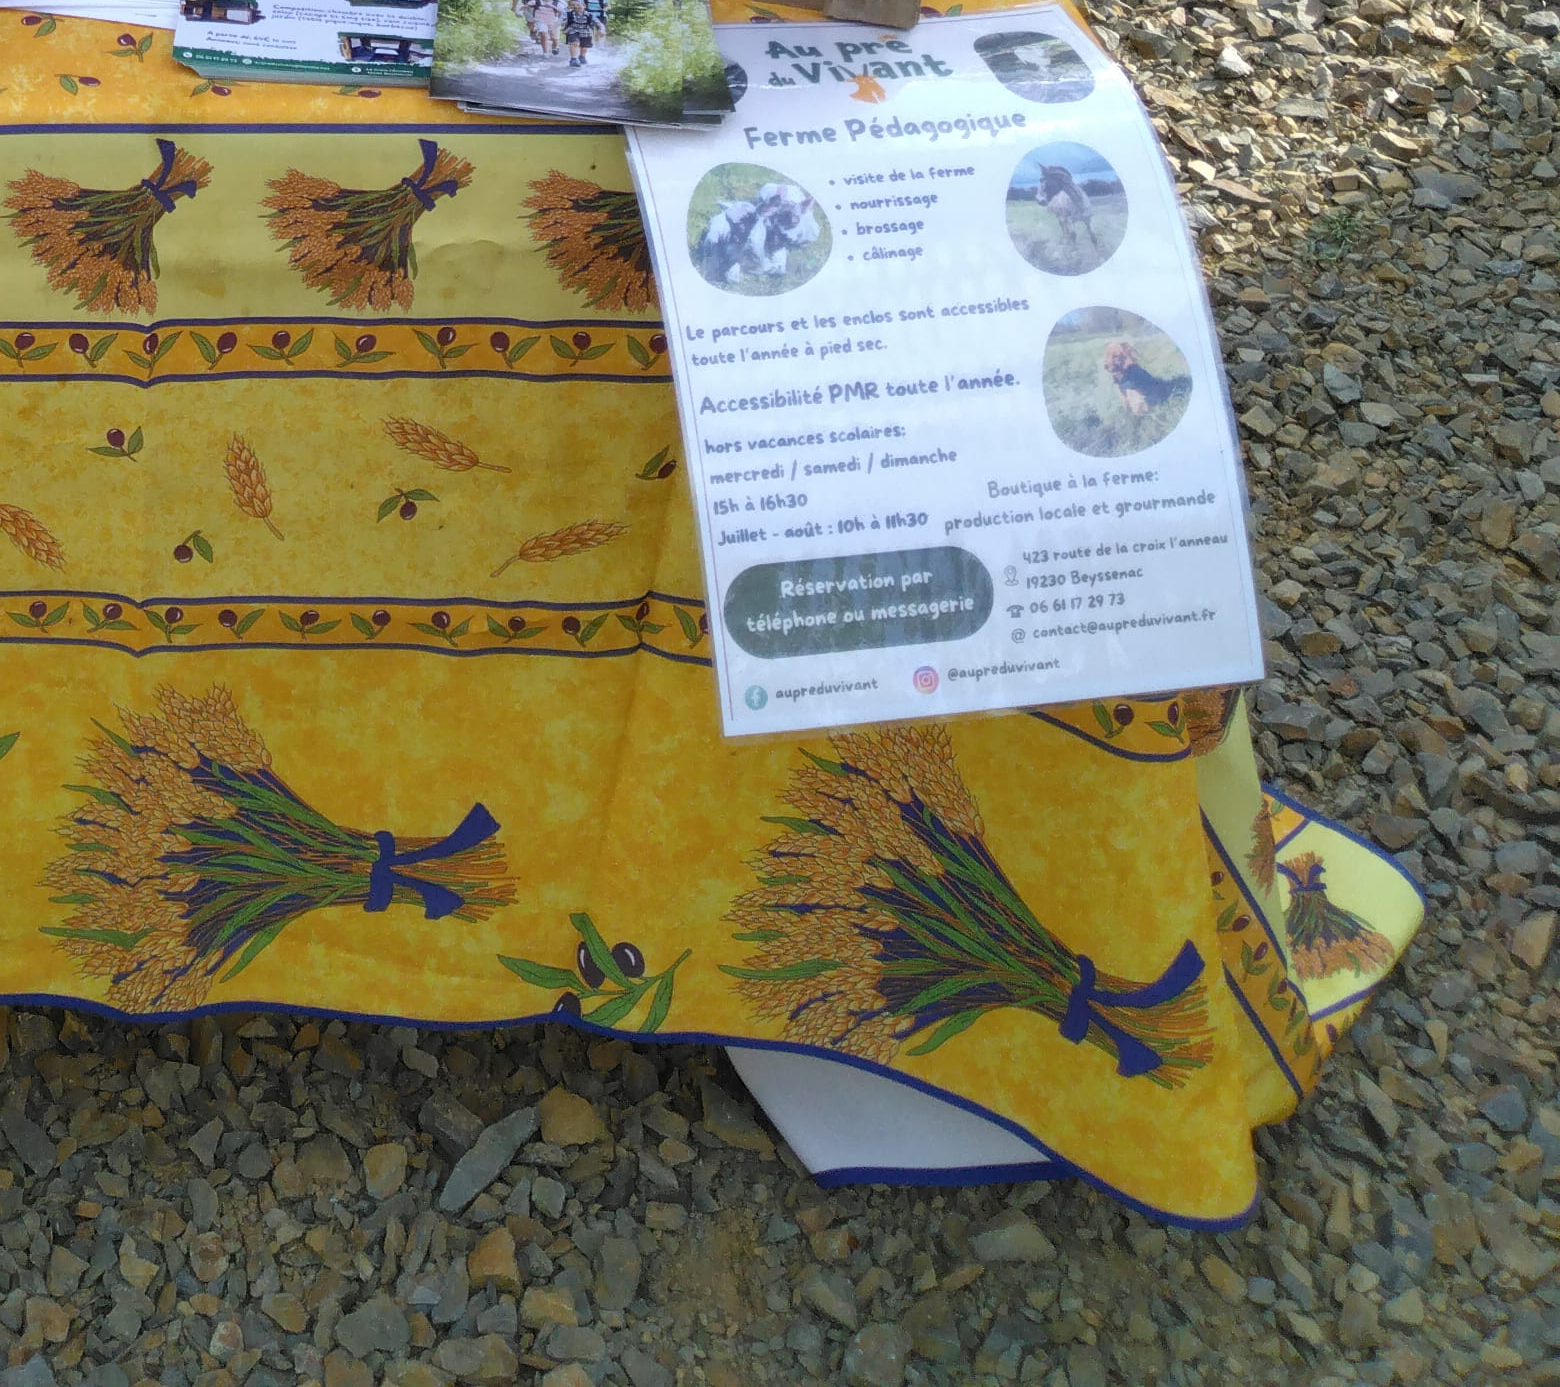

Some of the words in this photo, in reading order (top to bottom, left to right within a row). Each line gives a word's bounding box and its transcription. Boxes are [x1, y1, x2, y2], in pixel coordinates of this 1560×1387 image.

[765, 40, 823, 59] Au
[768, 72, 796, 88] du
[791, 53, 954, 84] Vivant
[743, 125, 837, 151] Ferme
[844, 111, 1026, 142] Pédagogique
[844, 173, 884, 187] visite
[889, 169, 906, 183] de
[910, 167, 925, 181] la
[929, 164, 975, 178] ferme
[849, 192, 939, 212] nourrissage
[856, 219, 924, 236] brossage
[862, 246, 924, 262] câlinage
[686, 325, 705, 342] Le
[712, 320, 785, 343] parcours
[791, 317, 809, 332] et
[813, 314, 837, 330] les
[843, 310, 893, 327] enclos
[898, 305, 936, 321] sont
[940, 297, 1030, 318] accessibles
[691, 351, 736, 367] toute
[739, 343, 799, 364] l'année
[804, 341, 815, 357] à
[819, 337, 852, 360] pied
[858, 337, 888, 352] sec.
[699, 385, 824, 416] Accessibilité
[828, 381, 880, 404] PMR
[885, 379, 939, 398] toute
[943, 369, 1021, 392] l'année.
[704, 438, 743, 454] hors
[747, 432, 825, 451] vacances
[828, 424, 907, 444] scolaires:
[709, 465, 784, 485] mercredi
[803, 457, 861, 477] samedi
[880, 448, 958, 470] dimanche
[987, 479, 1062, 499] Boutique
[1067, 473, 1077, 489] à
[1082, 474, 1097, 489] la
[1102, 469, 1159, 486] ferme:
[713, 499, 739, 516] 15h
[744, 495, 756, 511] à
[760, 493, 809, 512] 16h30
[944, 509, 1034, 535] production
[1039, 503, 1086, 521] locale
[1092, 501, 1110, 515] et
[1115, 489, 1216, 518] grourmande
[717, 529, 768, 547] Juillet
[784, 521, 824, 539] août
[837, 516, 866, 534] 10h
[871, 513, 881, 530] à
[885, 511, 929, 529] 11h30
[1022, 551, 1049, 565] 423
[1053, 547, 1091, 561] route
[1096, 543, 1111, 557] de
[1116, 541, 1129, 554] la
[1132, 539, 1166, 553] croix
[1169, 534, 1228, 549] l'anneau
[780, 573, 895, 598] Réservation
[901, 570, 933, 591] par
[1026, 574, 1066, 589] 19230
[1070, 568, 1143, 587] Beyssenac
[746, 610, 837, 635] téléphone
[843, 608, 864, 622] ou
[871, 596, 975, 620] messagerie
[1030, 600, 1048, 614] 06
[1052, 598, 1066, 612] 61
[1088, 594, 1104, 608] 29
[1109, 593, 1125, 606] 73
[1033, 608, 1216, 640] contact@aupreduvivant.fr
[947, 658, 1061, 682] @aupreduvivant
[775, 678, 879, 702] aupreduvivant
